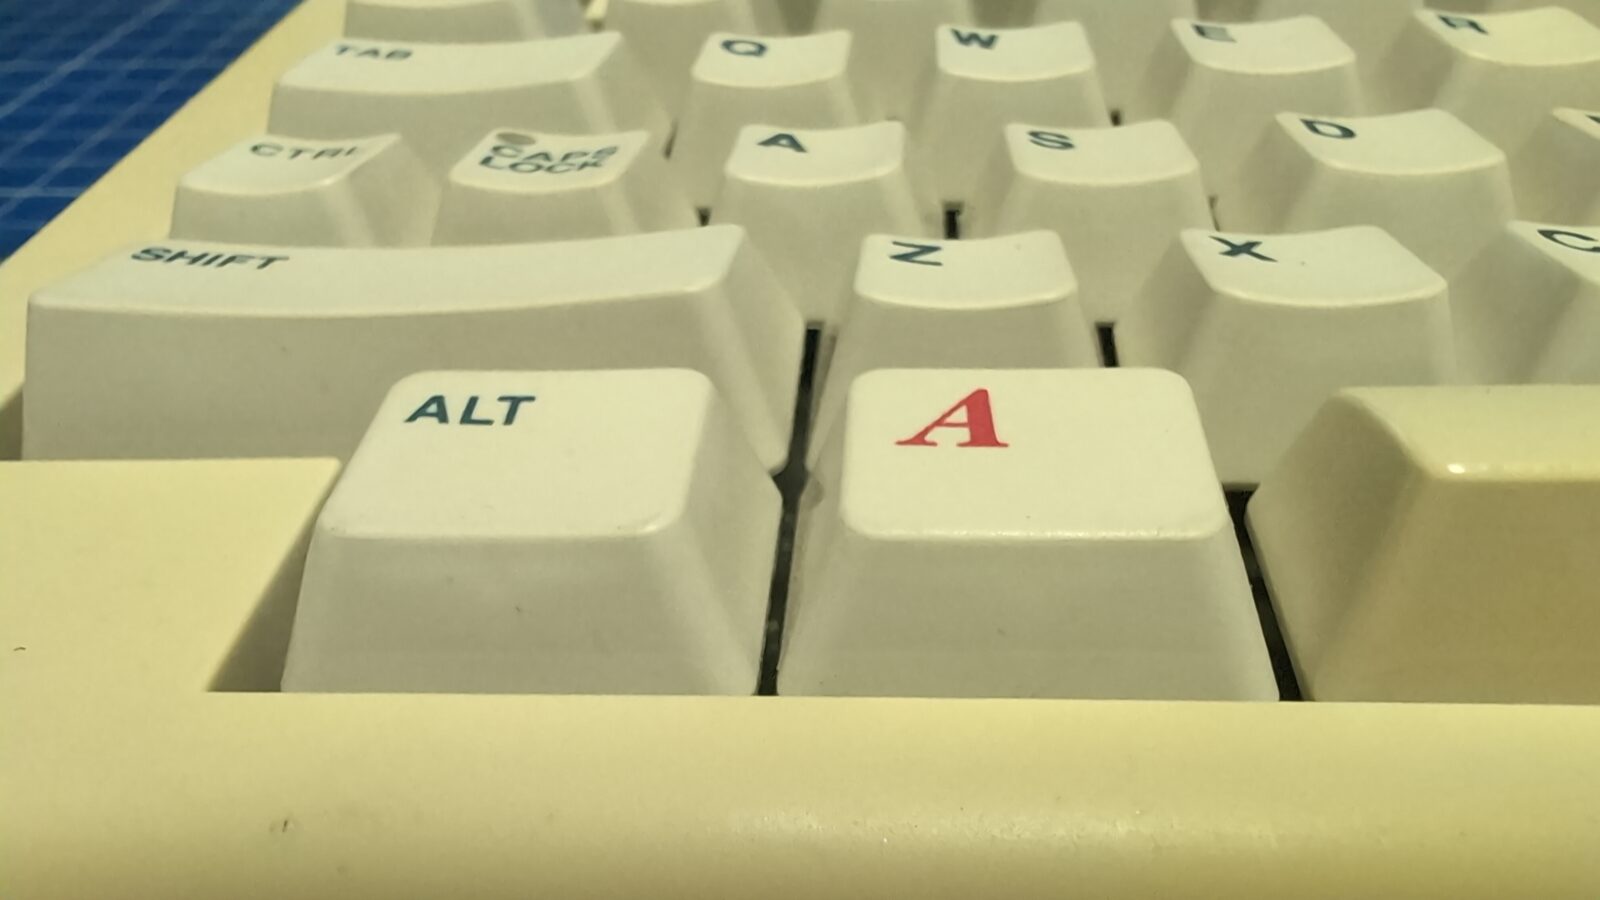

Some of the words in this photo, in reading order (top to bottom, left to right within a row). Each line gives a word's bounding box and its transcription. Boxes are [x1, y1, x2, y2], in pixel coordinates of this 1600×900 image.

[721, 39, 767, 57] Q
[951, 28, 999, 49] W
[334, 44, 412, 60] TAB
[1300, 119, 1356, 139] D
[757, 133, 808, 153] A
[1027, 131, 1076, 150] S
[491, 144, 618, 164] CAPS
[478, 156, 604, 174] LOCK
[131, 247, 290, 270] SHIFT
[889, 241, 943, 266] Z
[1208, 236, 1278, 262] X
[404, 395, 536, 426] ALT
[895, 388, 1009, 448] A
